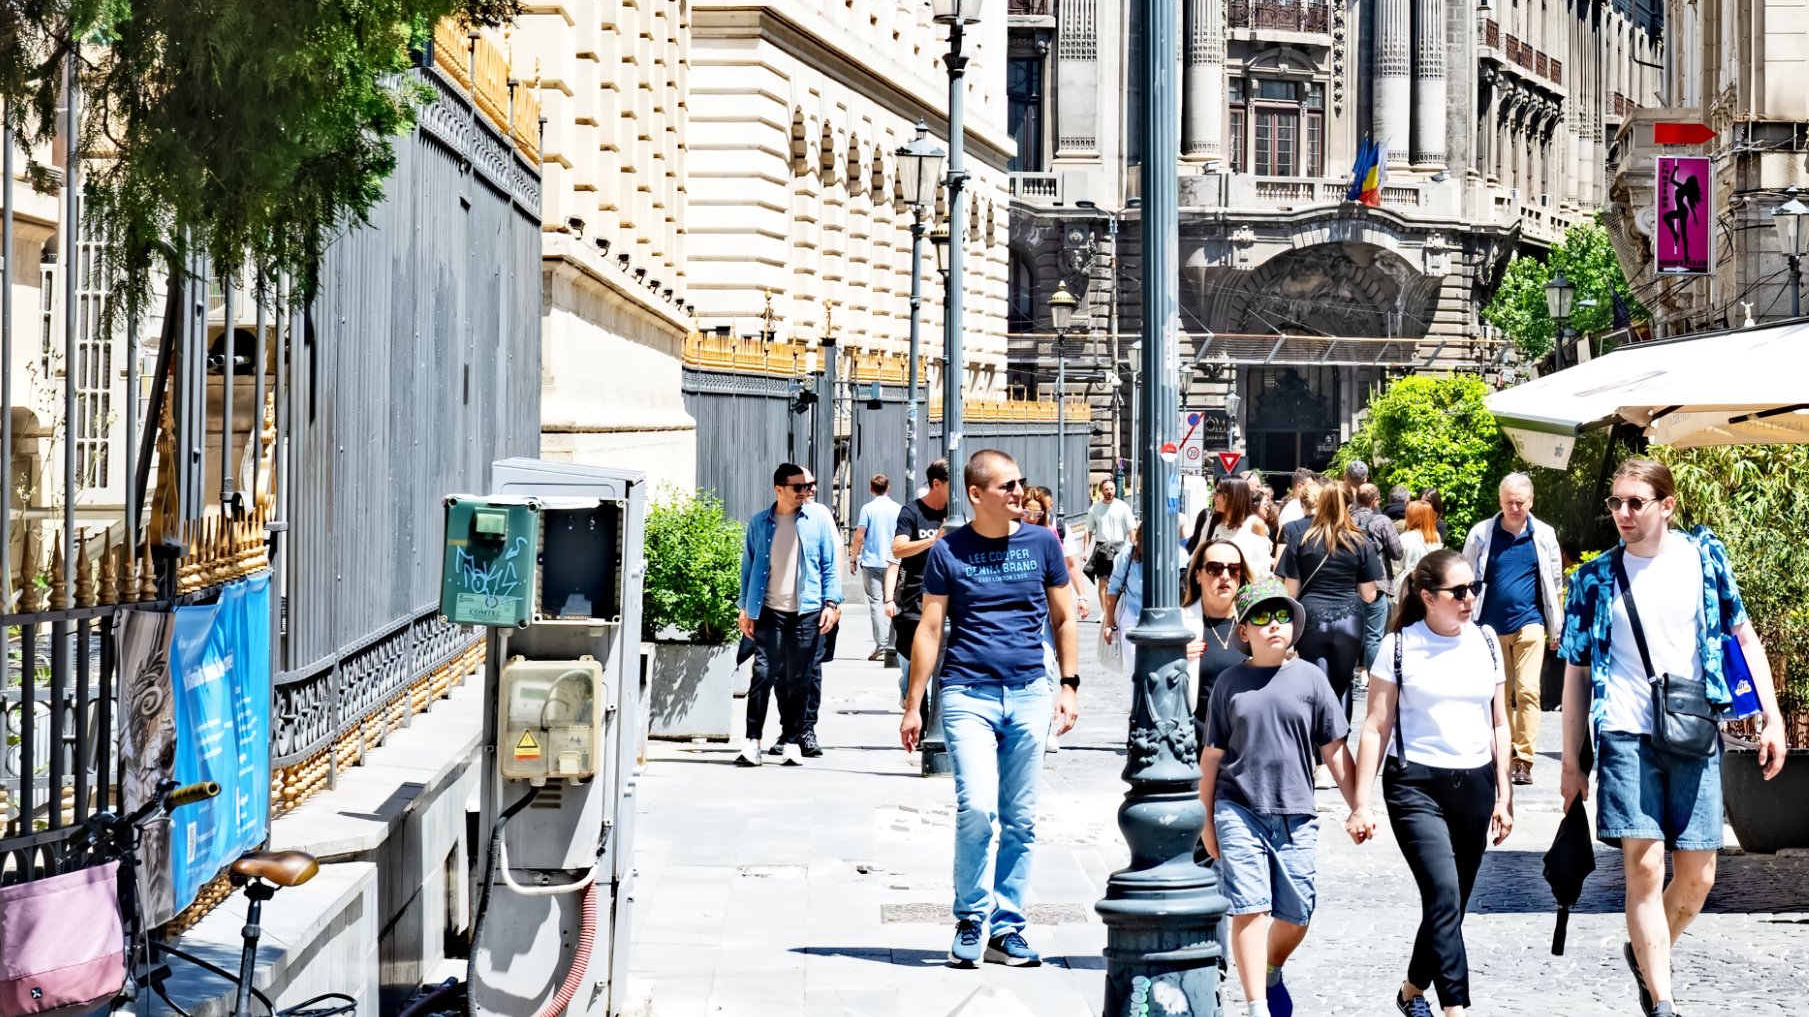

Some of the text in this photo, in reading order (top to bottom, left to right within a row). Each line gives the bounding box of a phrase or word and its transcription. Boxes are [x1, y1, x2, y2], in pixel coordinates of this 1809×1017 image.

[969, 548, 1030, 564] LEE COOPER
[965, 560, 1038, 577] DENIM BRAND
